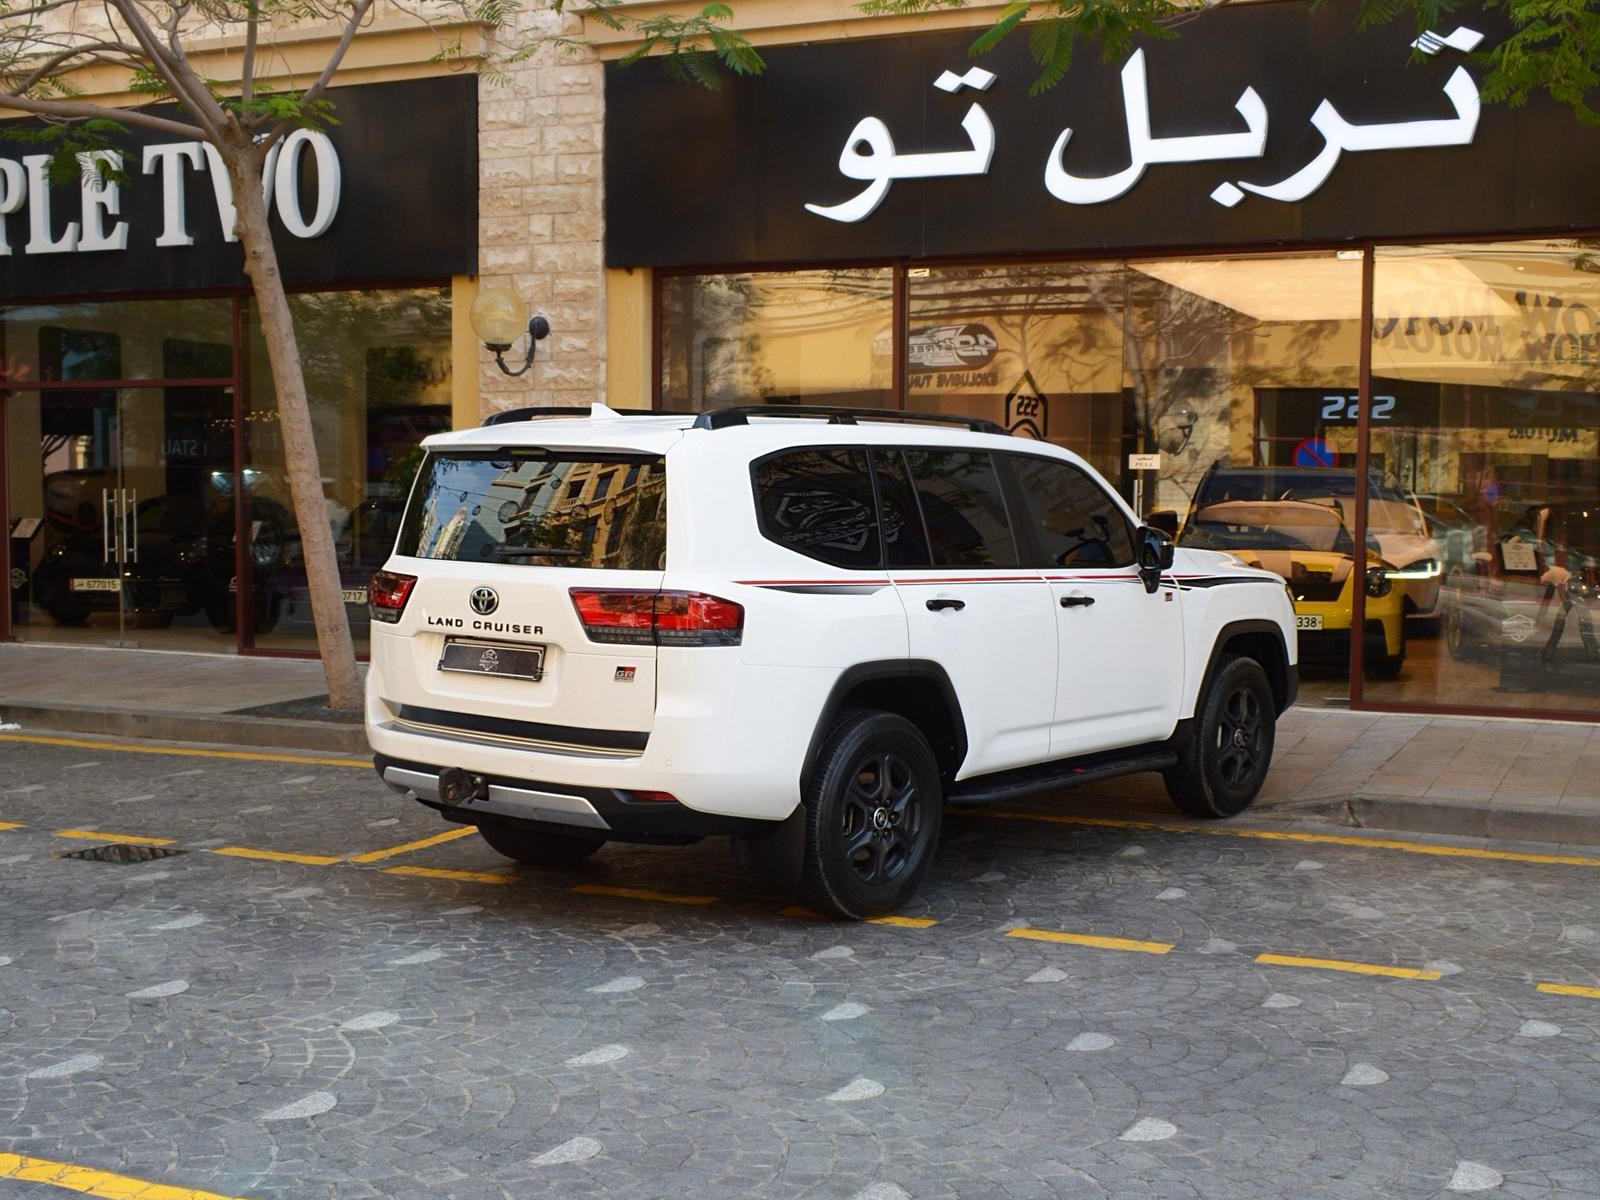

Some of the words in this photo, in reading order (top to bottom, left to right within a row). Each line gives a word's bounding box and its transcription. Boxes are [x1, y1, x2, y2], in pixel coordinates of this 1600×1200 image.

[804, 66, 997, 223] تو
[428, 616, 463, 628] LAND
[473, 620, 544, 635] CRUISER
